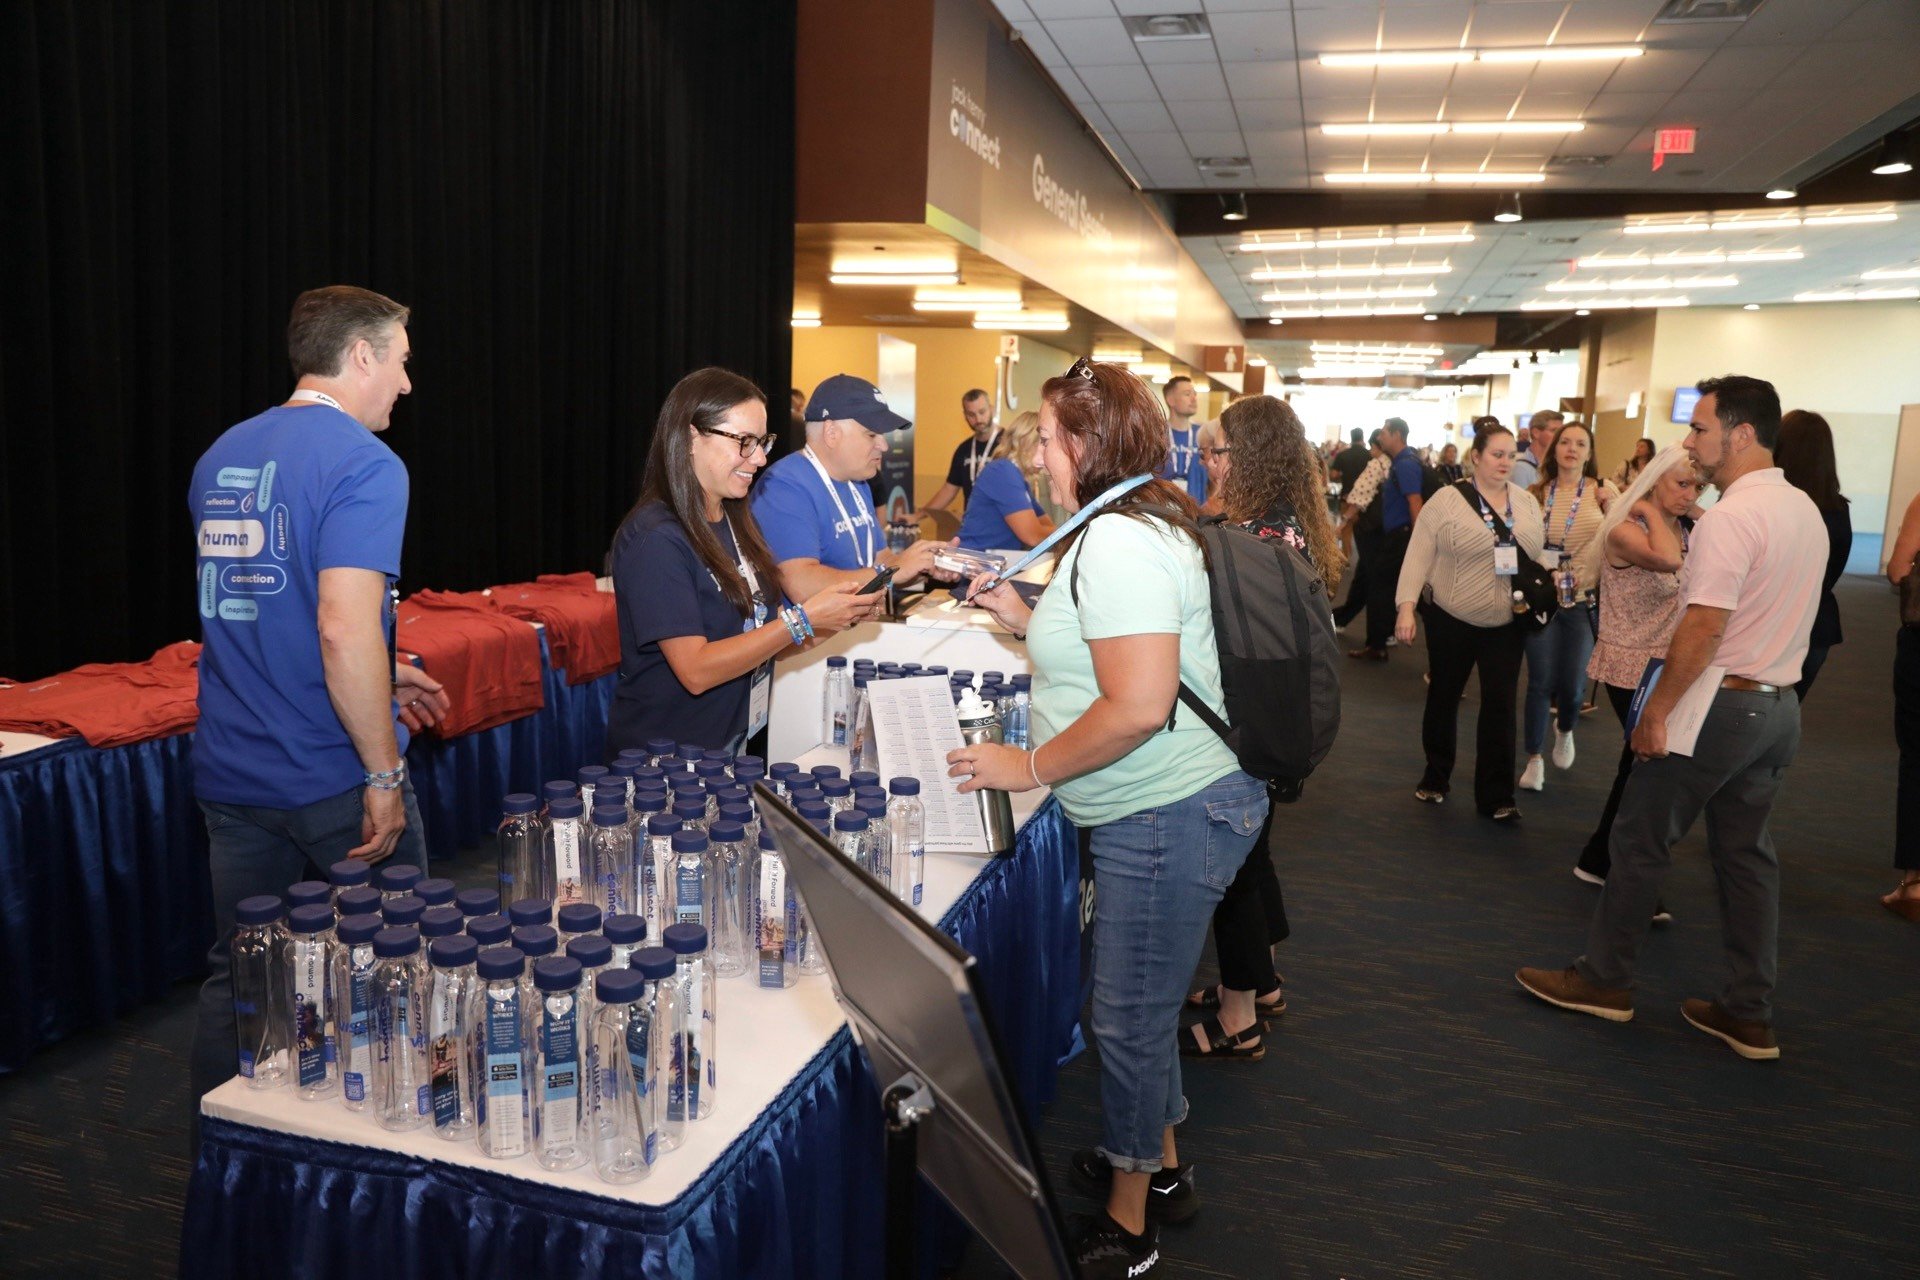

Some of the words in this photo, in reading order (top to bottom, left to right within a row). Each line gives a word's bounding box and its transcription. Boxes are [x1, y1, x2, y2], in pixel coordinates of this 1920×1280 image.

[951, 79, 966, 107] jack
[1032, 153, 1080, 232] General
[206, 498, 236, 506] reflection
[277, 512, 286, 551] empathy
[770, 877, 778, 908] Forward
[754, 897, 764, 951] connect
[1128, 1250, 1159, 1278] HOKA
